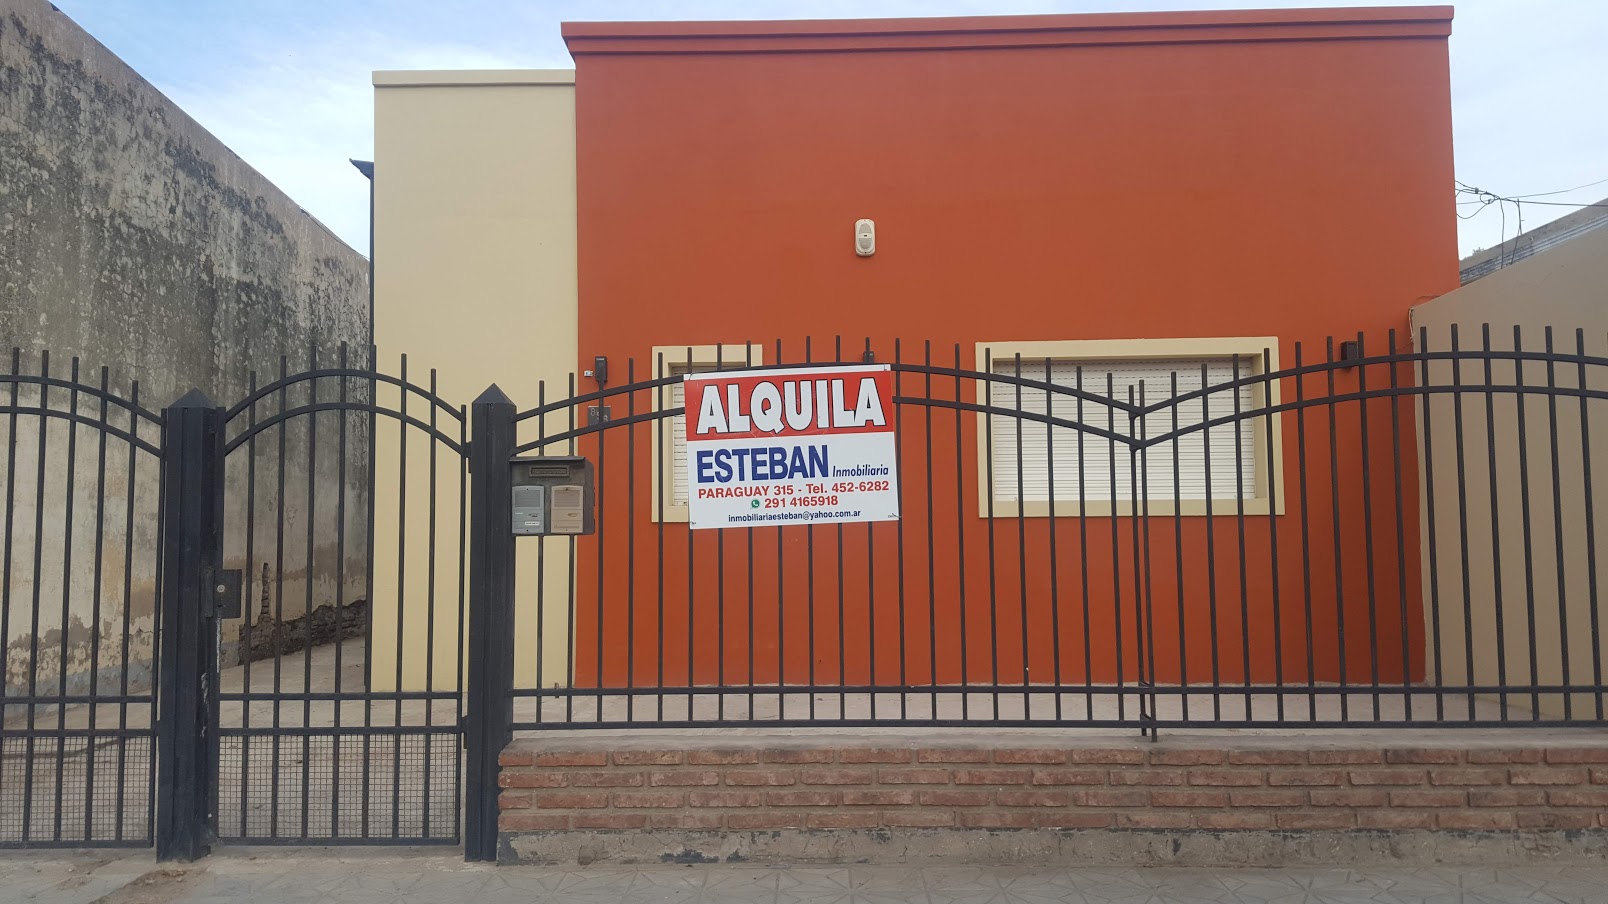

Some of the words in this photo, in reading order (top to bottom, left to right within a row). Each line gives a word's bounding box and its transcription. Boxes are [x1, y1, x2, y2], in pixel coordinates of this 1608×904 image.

[696, 377, 887, 434] ALQUILA
[696, 445, 829, 483] ESTEBAN
[832, 464, 889, 478] Inmobiliaria
[698, 486, 769, 499] PARAGUAY
[773, 485, 794, 496] 315
[806, 483, 828, 494] Tel.
[831, 481, 889, 493] 452-6282
[764, 498, 786, 508] 291
[790, 495, 838, 507] 4165918
[728, 510, 860, 522] inmobiliariaesteban@yahoo.com.ar
